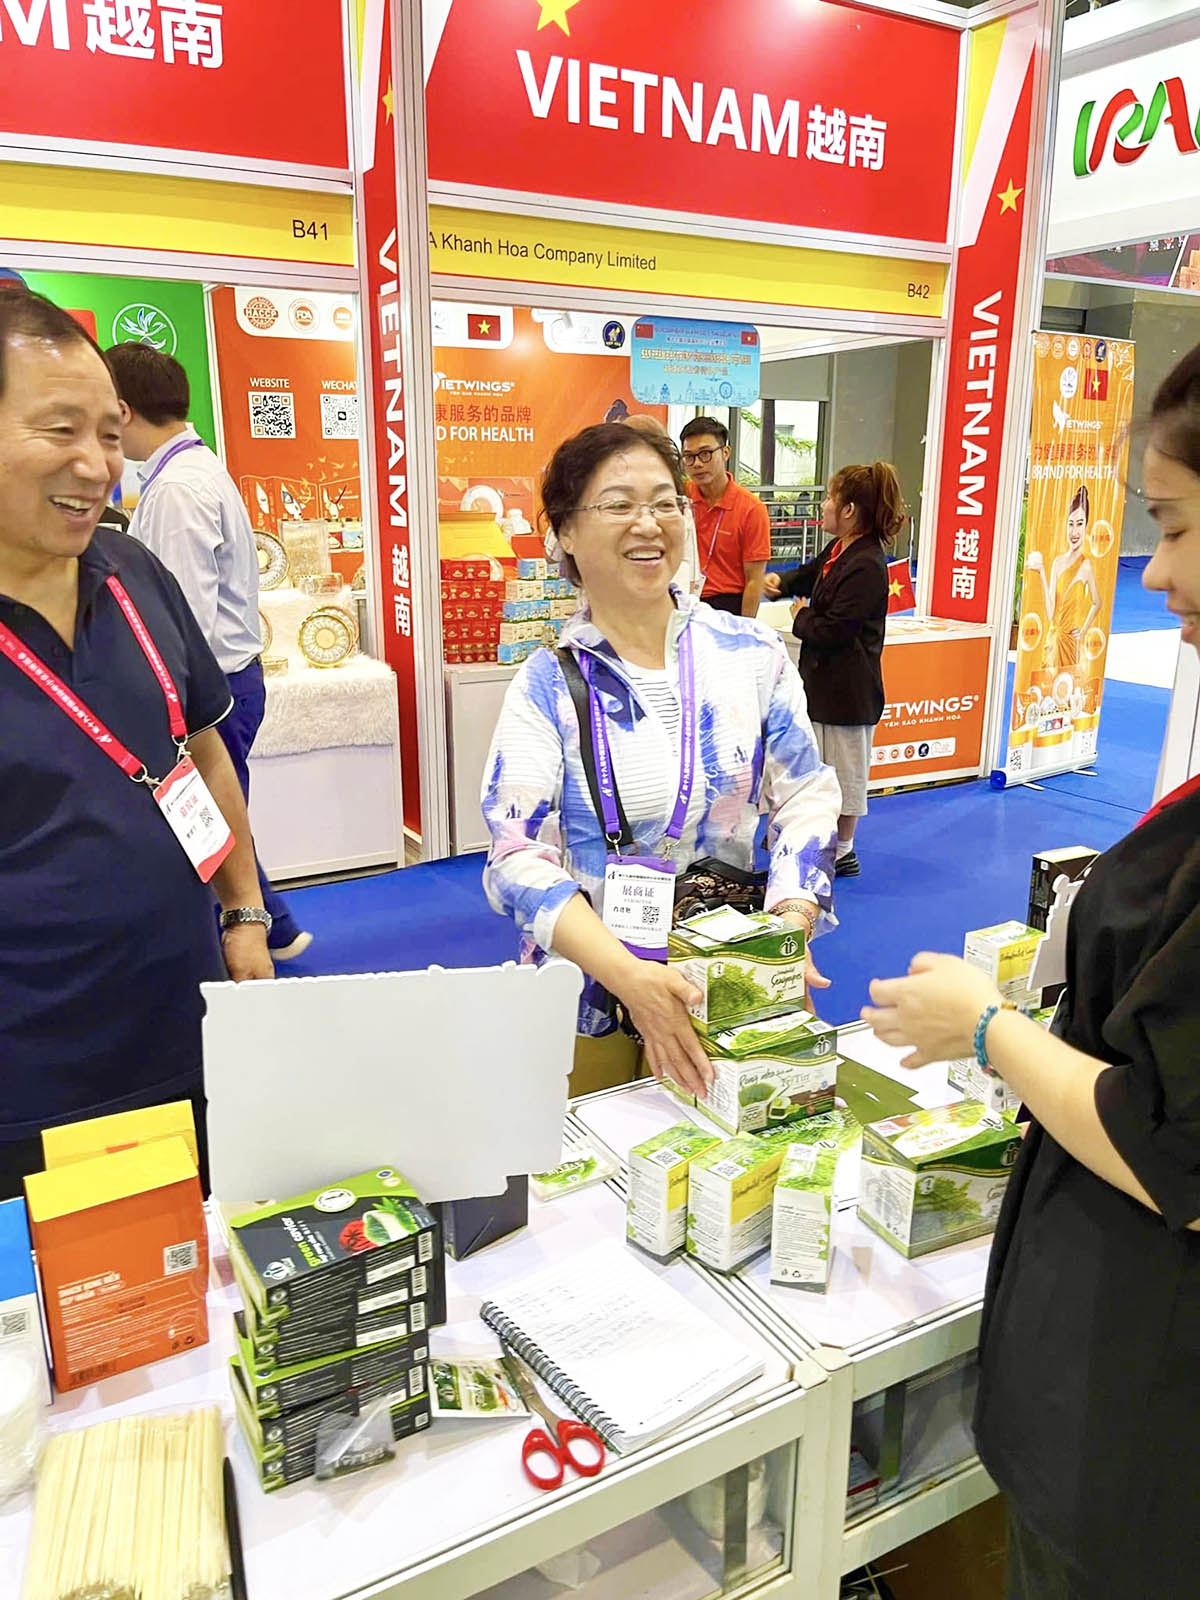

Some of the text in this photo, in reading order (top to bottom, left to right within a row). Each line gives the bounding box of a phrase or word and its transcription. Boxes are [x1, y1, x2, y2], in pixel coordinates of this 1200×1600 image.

[82, 0, 223, 69] 越南
[515, 49, 887, 171] VIETNAM 越南
[1073, 76, 1200, 177] IRA
[292, 219, 328, 241] B41
[442, 233, 493, 255] Khanh
[498, 239, 529, 258] Hoa
[533, 243, 604, 269] Company
[607, 250, 656, 271] Limited
[907, 283, 930, 299] B42
[250, 377, 290, 389] WEBSITE
[378, 227, 411, 638] VIETNAM 越南
[450, 426, 478, 442] FOR
[481, 426, 534, 443] HEALTH
[951, 290, 1003, 600] VIETNAM 越南
[1032, 464, 1064, 480] BRAND
[1065, 464, 1083, 480] FOR
